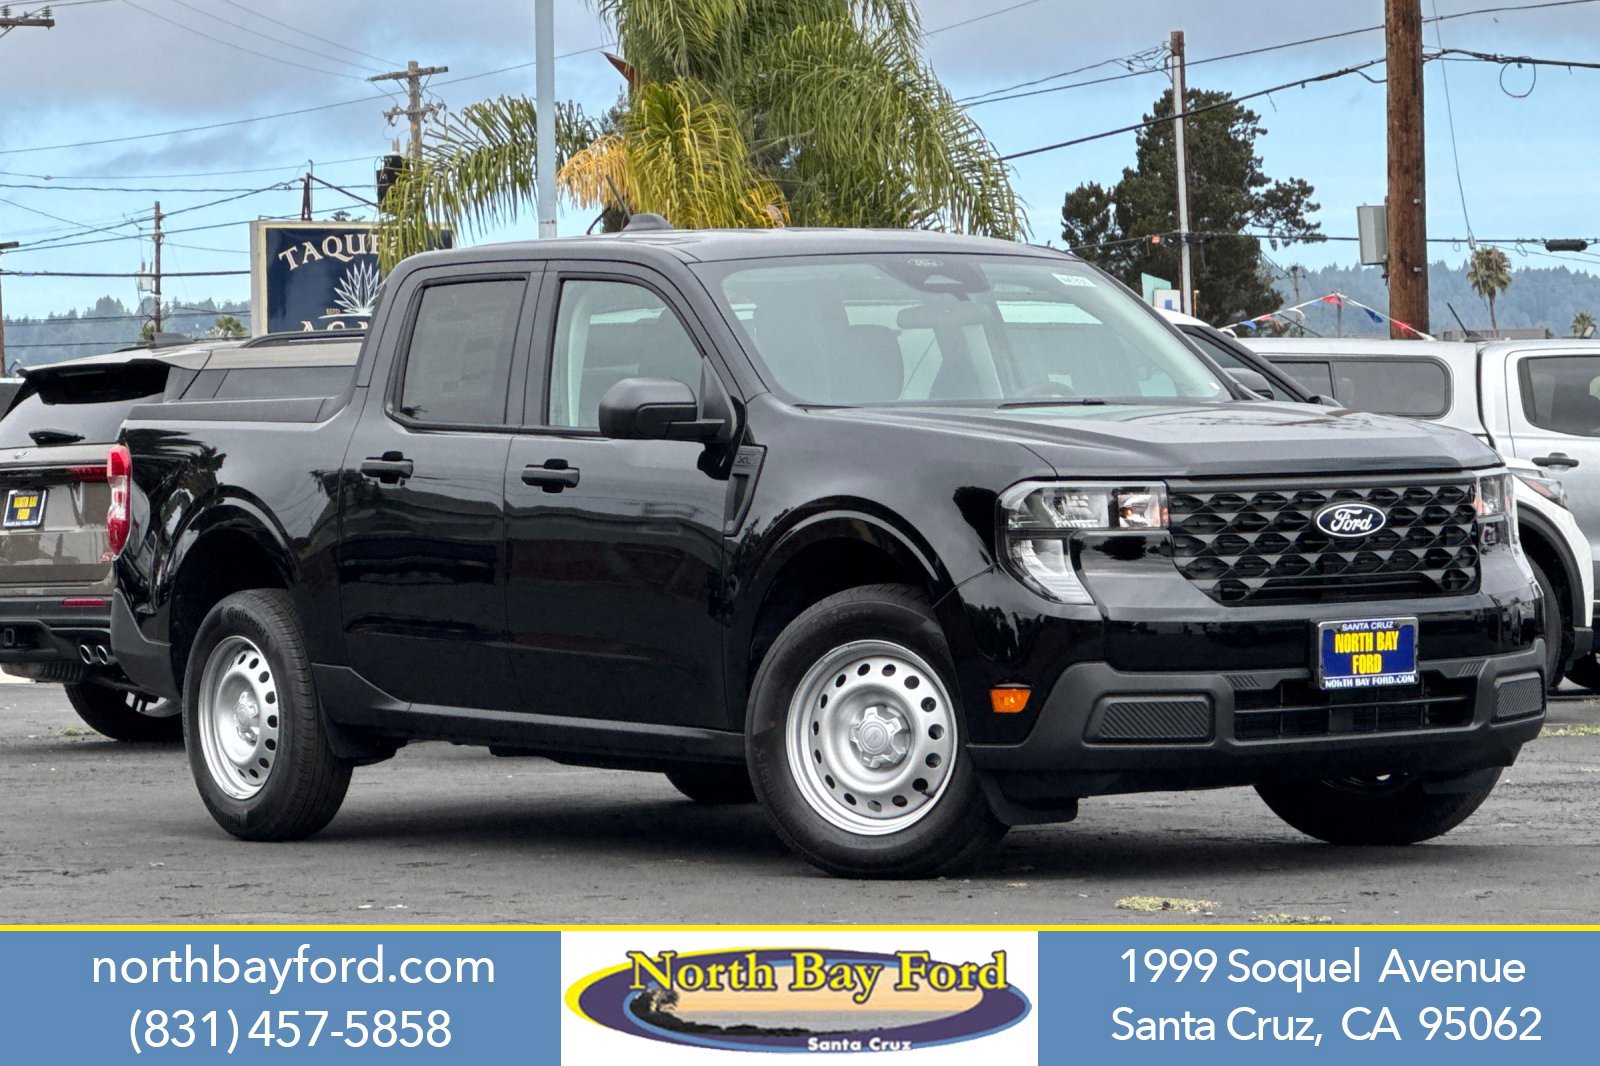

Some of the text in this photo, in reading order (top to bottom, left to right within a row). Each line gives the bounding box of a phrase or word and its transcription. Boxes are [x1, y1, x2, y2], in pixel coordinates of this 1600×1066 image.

[1330, 508, 1373, 532] Ford
[1342, 620, 1394, 631] SANTA CRUZ
[1334, 631, 1399, 654] NORTH BAY
[1352, 653, 1382, 675] FORD
[1325, 674, 1414, 688] NORTH BAY FORD.COM
